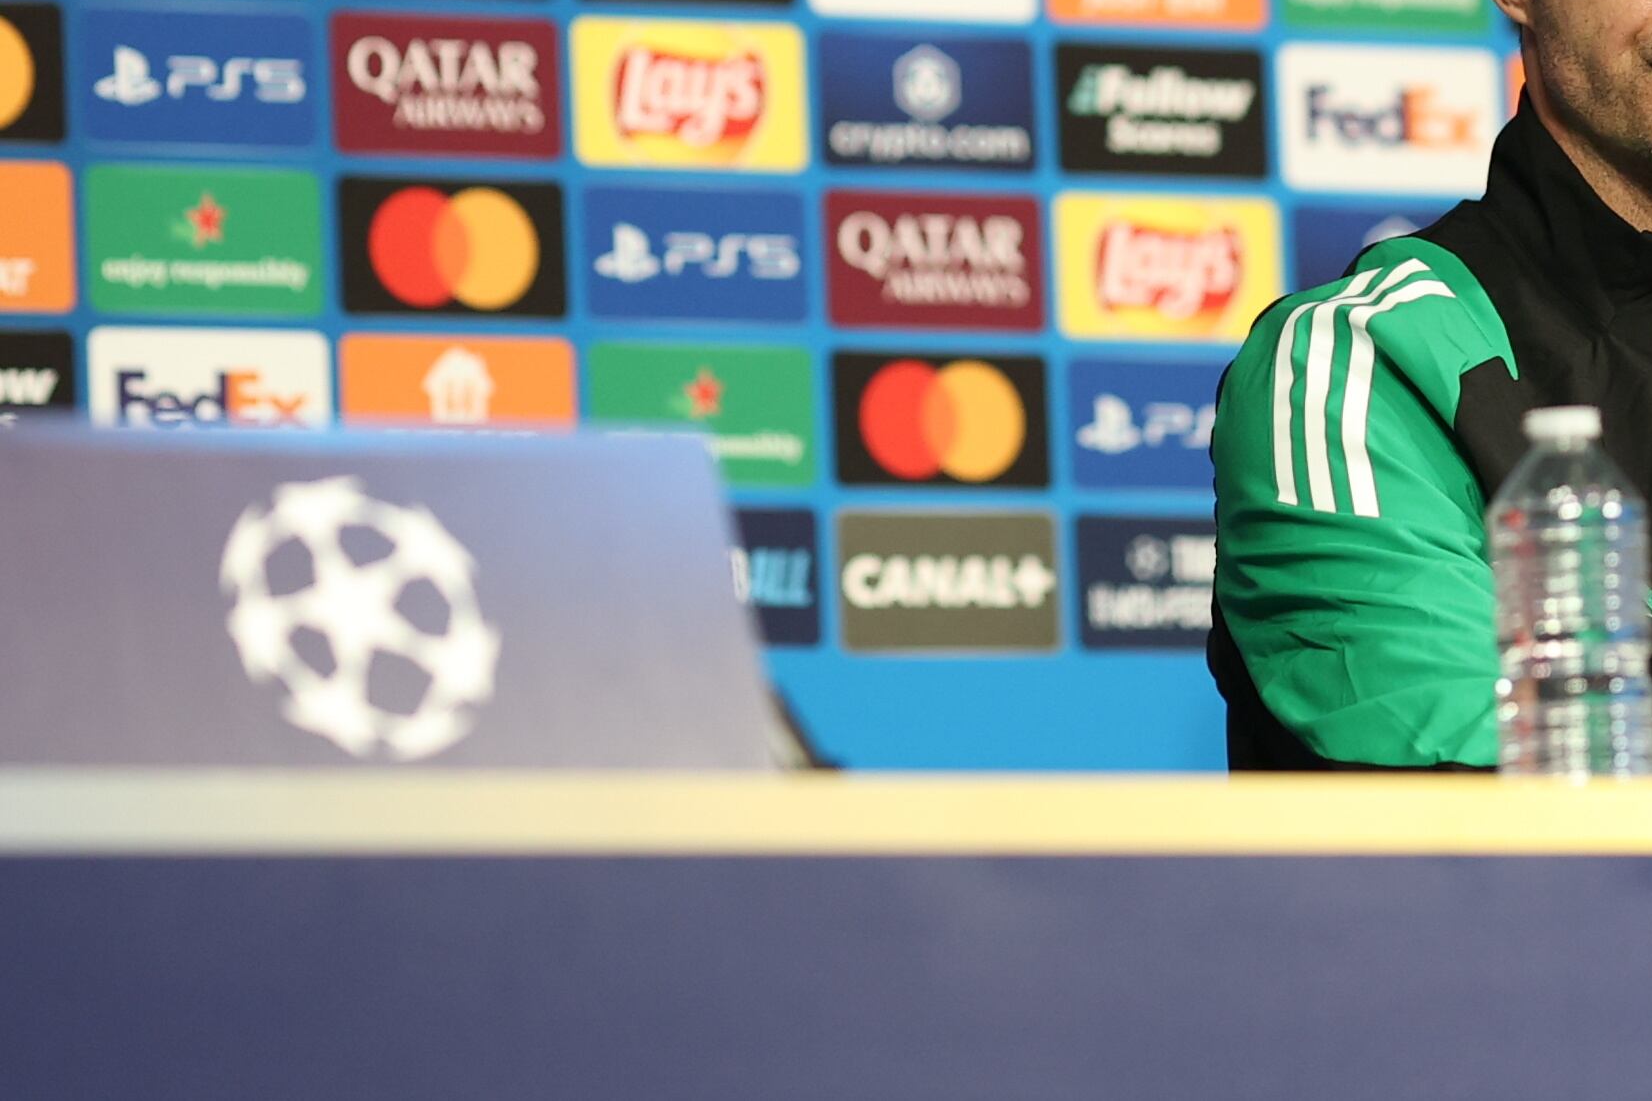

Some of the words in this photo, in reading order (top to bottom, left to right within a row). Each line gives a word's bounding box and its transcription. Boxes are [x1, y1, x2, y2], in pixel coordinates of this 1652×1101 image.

[167, 55, 306, 102] PS5
[347, 35, 540, 101] QATAR
[617, 45, 764, 144] Lay's
[394, 97, 546, 133] AIRWAYS
[828, 120, 1031, 162] crypto.com
[1304, 84, 1481, 150] FedEx
[663, 232, 800, 280] PS5
[837, 211, 1025, 276] QATAR
[1098, 219, 1240, 318] Lay's
[842, 553, 1056, 609] CANAL+
